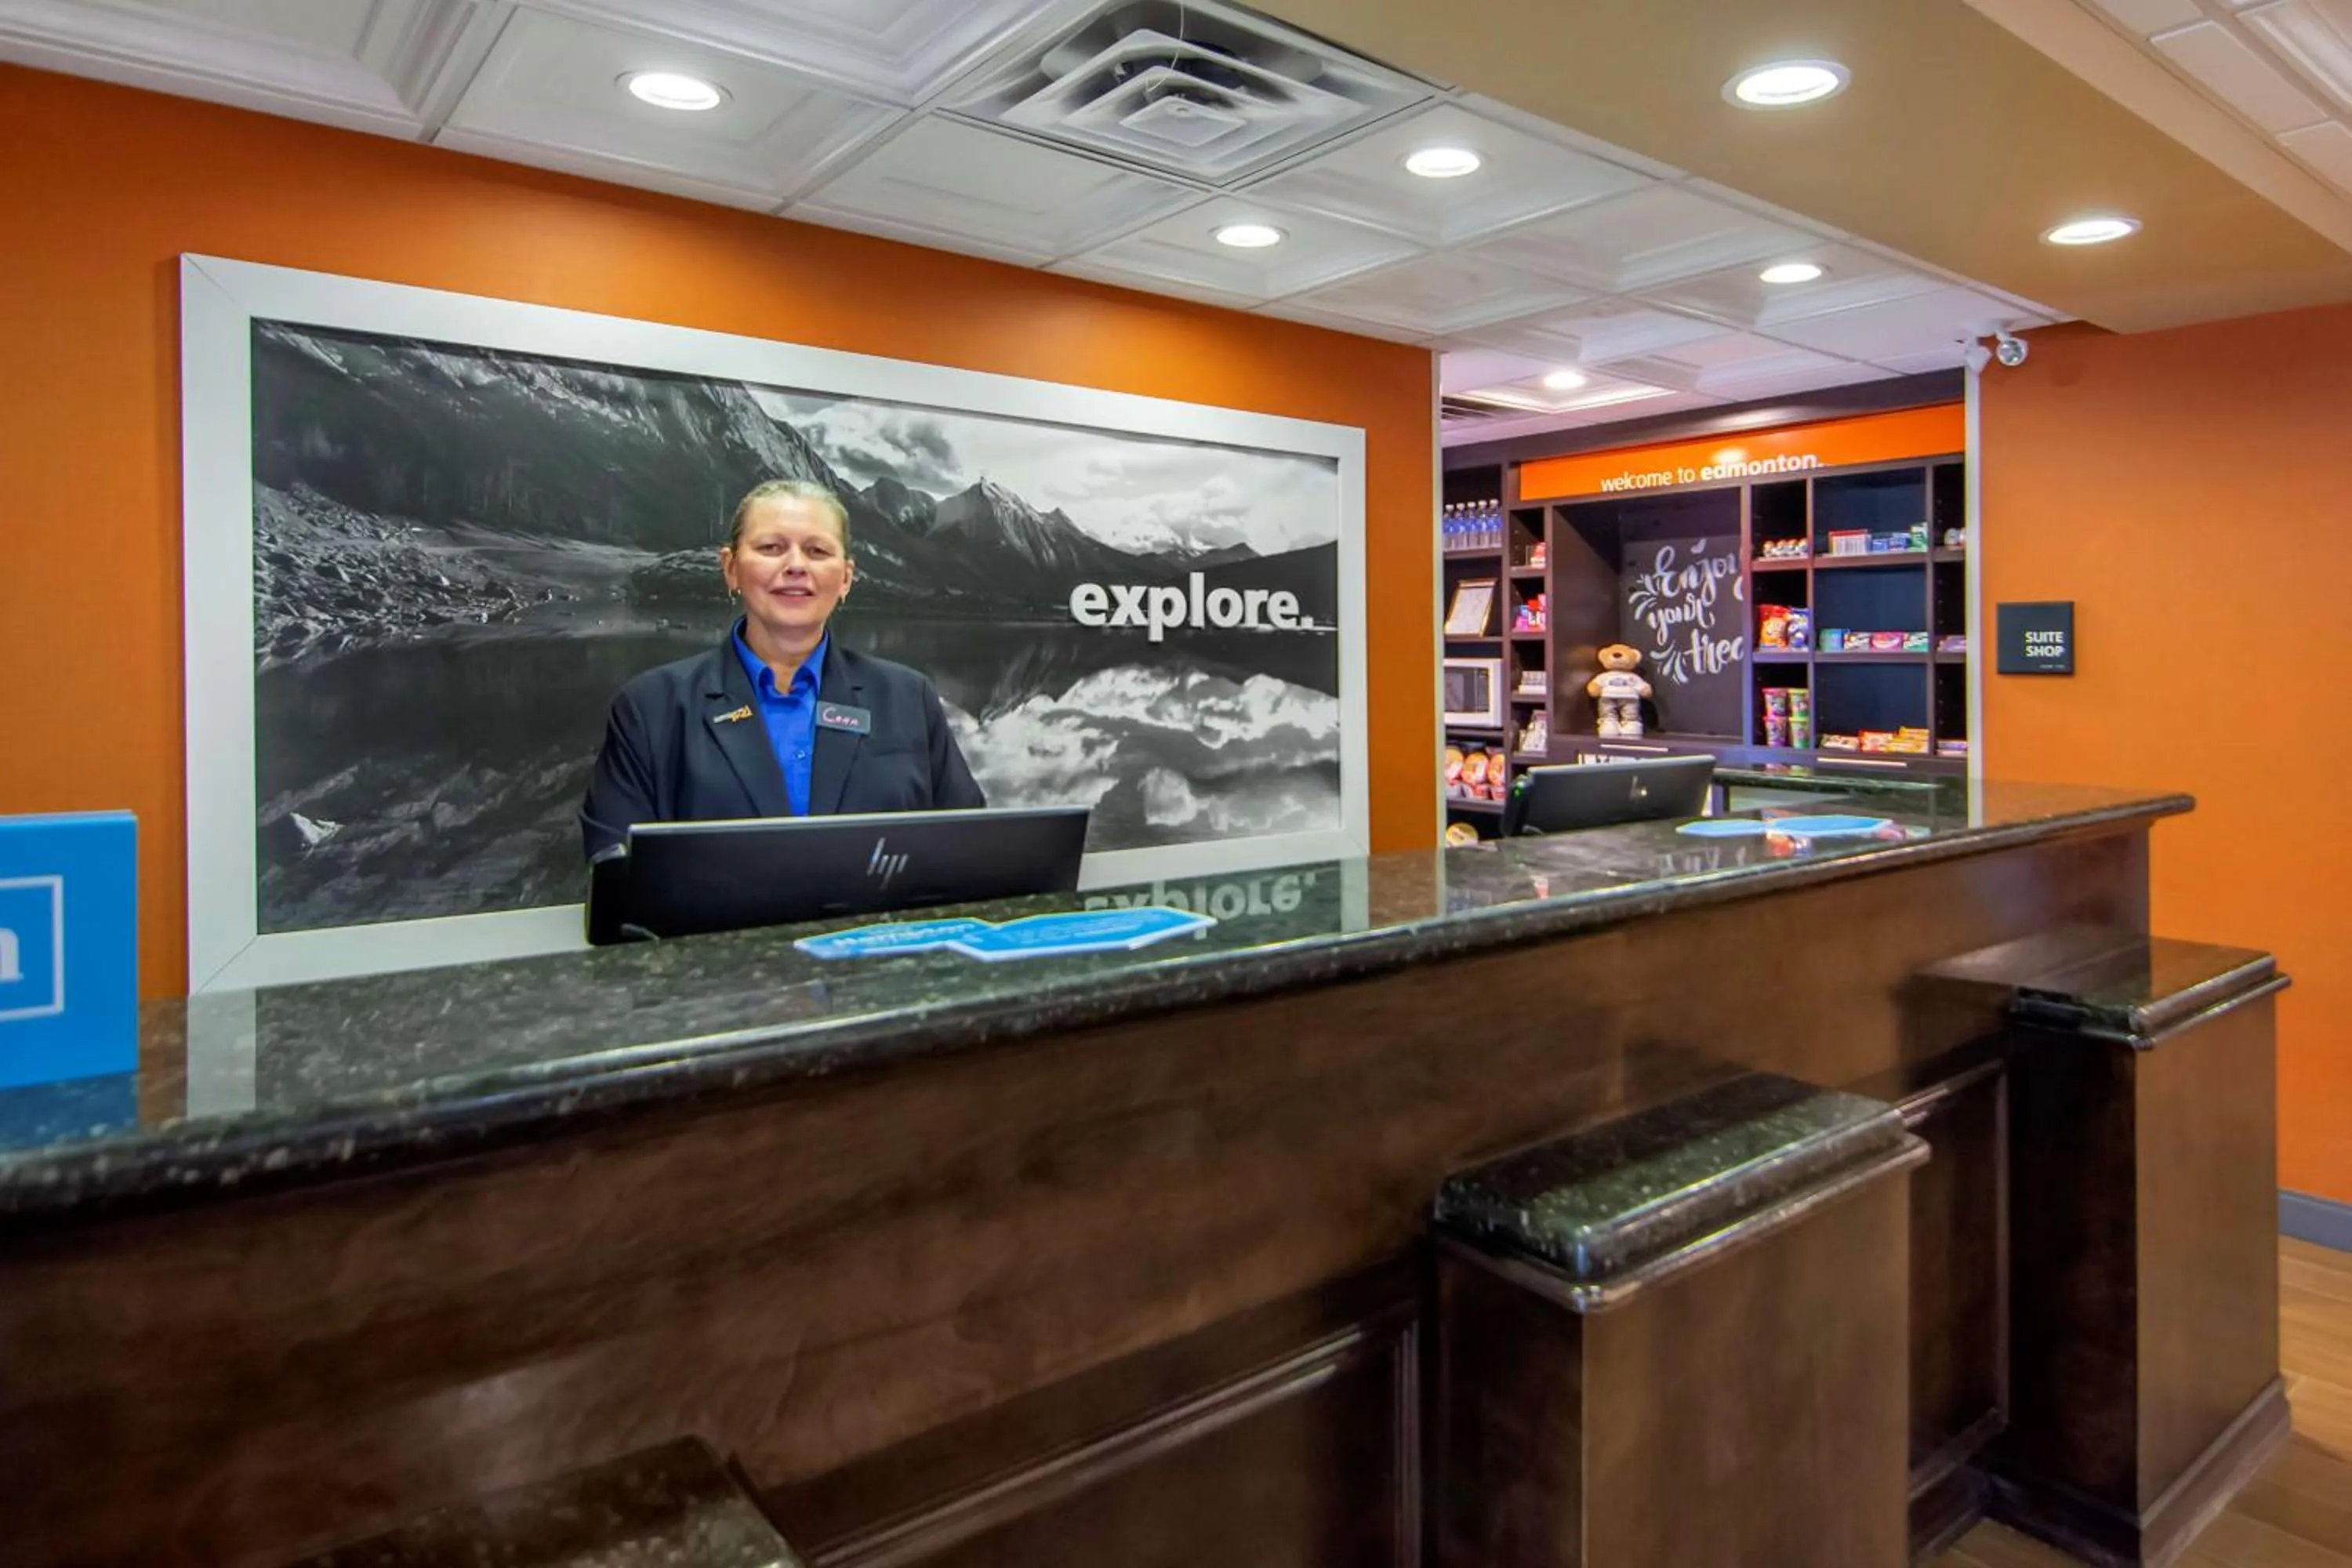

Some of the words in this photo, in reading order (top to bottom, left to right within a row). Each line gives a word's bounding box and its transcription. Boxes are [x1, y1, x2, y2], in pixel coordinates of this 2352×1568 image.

[1600, 471, 1672, 492] welcome
[1678, 467, 1696, 485] to
[1700, 453, 1824, 481] edmonton.
[1069, 572, 1314, 643] explore.
[1648, 593, 1716, 646] your
[1683, 628, 1744, 674] trea
[2025, 630, 2064, 644] SUITE
[2025, 645, 2065, 658] SHOP
[866, 837, 909, 890] hp
